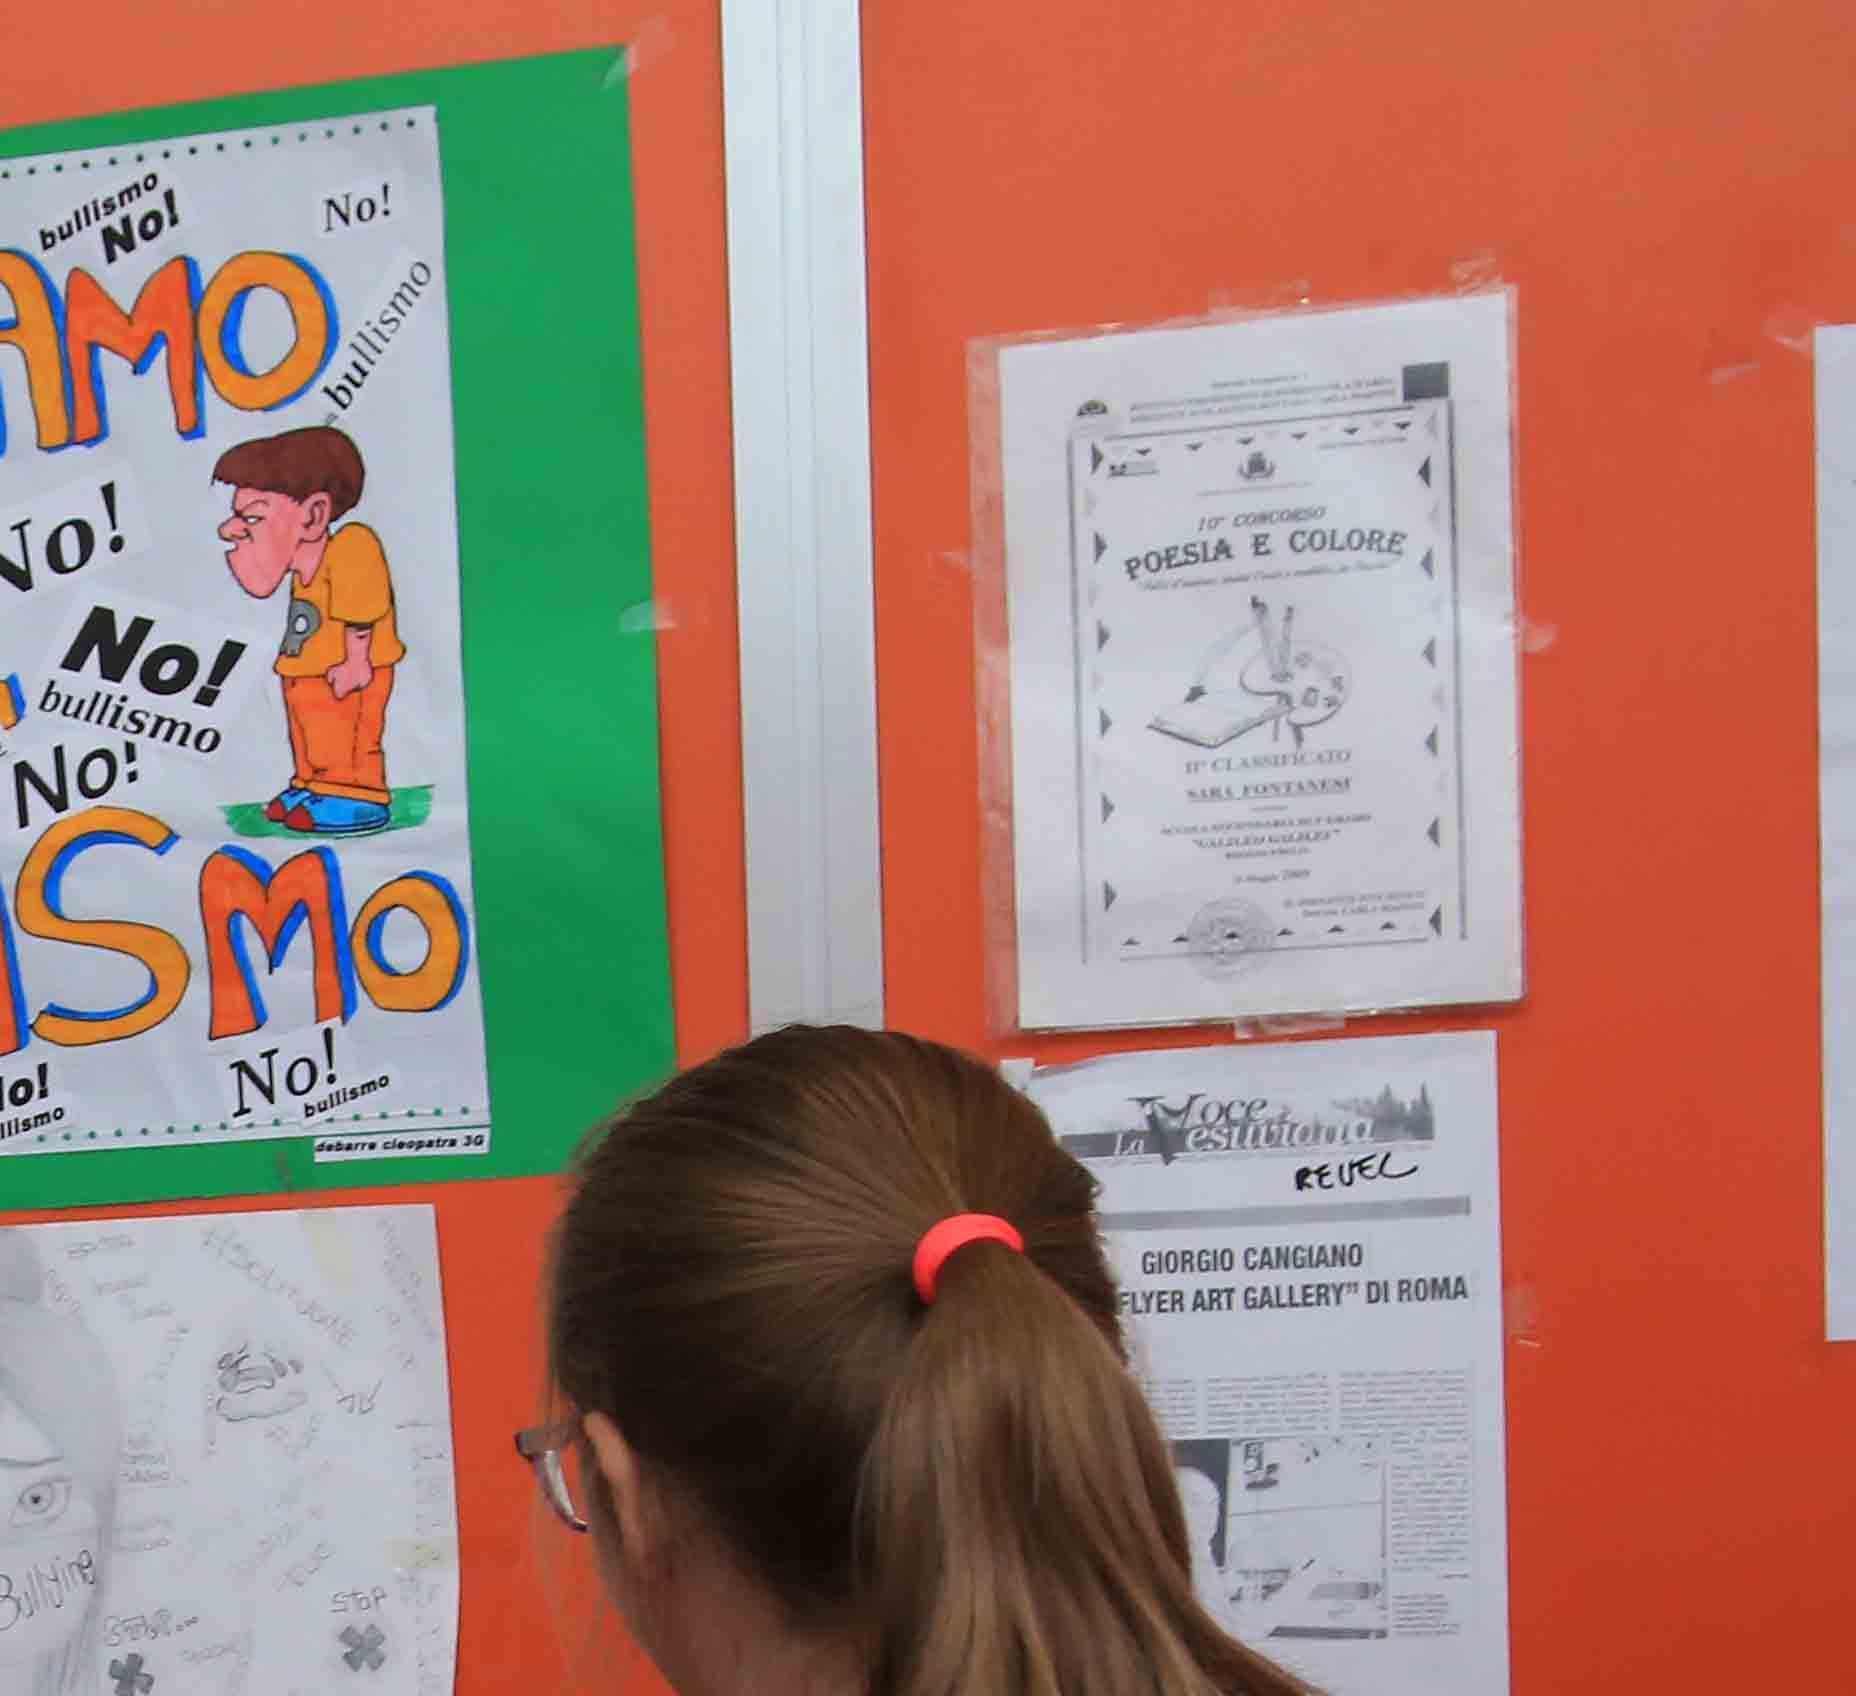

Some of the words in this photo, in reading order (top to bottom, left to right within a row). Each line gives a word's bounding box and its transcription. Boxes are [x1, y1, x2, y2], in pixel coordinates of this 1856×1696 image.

[38, 170, 159, 253] bullismo
[100, 188, 181, 265] No!
[322, 183, 392, 233] No!
[322, 259, 432, 413] bullismo
[1232, 506, 1327, 528] CONCORSO
[1124, 538, 1235, 580] POESIA
[1252, 533, 1272, 556] E
[1288, 528, 1408, 556] COLORE
[60, 606, 248, 707] No!
[38, 680, 222, 754] bullismo
[1211, 750, 1351, 771] CLASSIFICATO
[229, 1027, 338, 1120] No!
[303, 1073, 391, 1120] bullismo
[1143, 1248, 1235, 1275] GIORGIO
[1244, 1243, 1363, 1271] CANGIANO
[1192, 1288, 1235, 1312] ART
[1366, 1280, 1390, 1304] DI
[1397, 1276, 1469, 1302] ROMA
